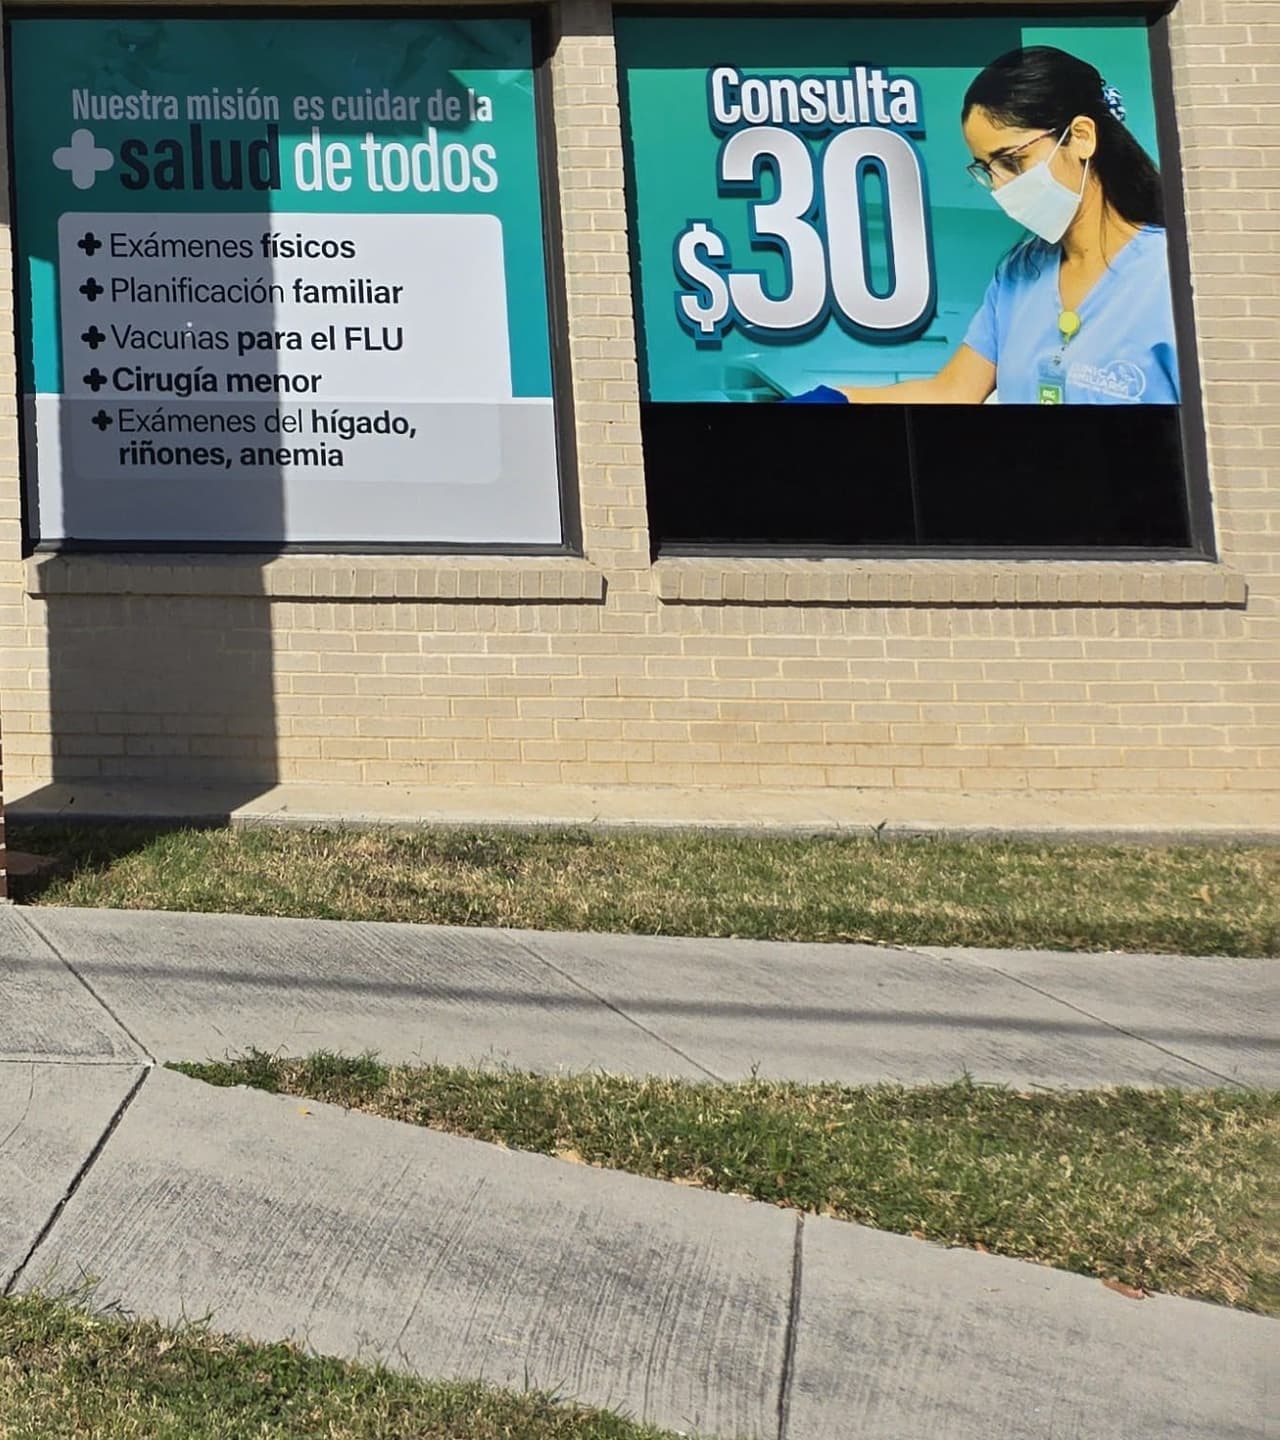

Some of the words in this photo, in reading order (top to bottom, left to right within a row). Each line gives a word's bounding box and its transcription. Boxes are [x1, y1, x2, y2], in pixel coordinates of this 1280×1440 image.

[71, 89, 179, 121] Nuestra
[186, 88, 280, 121] misión
[293, 95, 324, 121] es
[332, 89, 422, 121] cuidar
[427, 89, 461, 121] de
[468, 90, 493, 121] la
[711, 66, 918, 124] Consulta
[119, 124, 281, 191] salud
[294, 126, 352, 192] de
[361, 127, 499, 193] todos
[680, 126, 930, 332] $30
[110, 232, 253, 259] Exámenes
[260, 232, 356, 259] físicos
[111, 277, 284, 304] Planificación
[292, 277, 403, 305] familiar
[111, 324, 230, 350] Vacunas
[237, 332, 302, 356] para
[311, 326, 335, 350] el
[345, 327, 403, 351] FLU
[112, 366, 219, 397] Cirugía
[226, 373, 322, 393] menor
[118, 408, 255, 433] Exámenes
[264, 409, 303, 433] del
[311, 409, 417, 439] hígado,
[118, 441, 233, 470] riñones,
[240, 441, 344, 467] anemia
